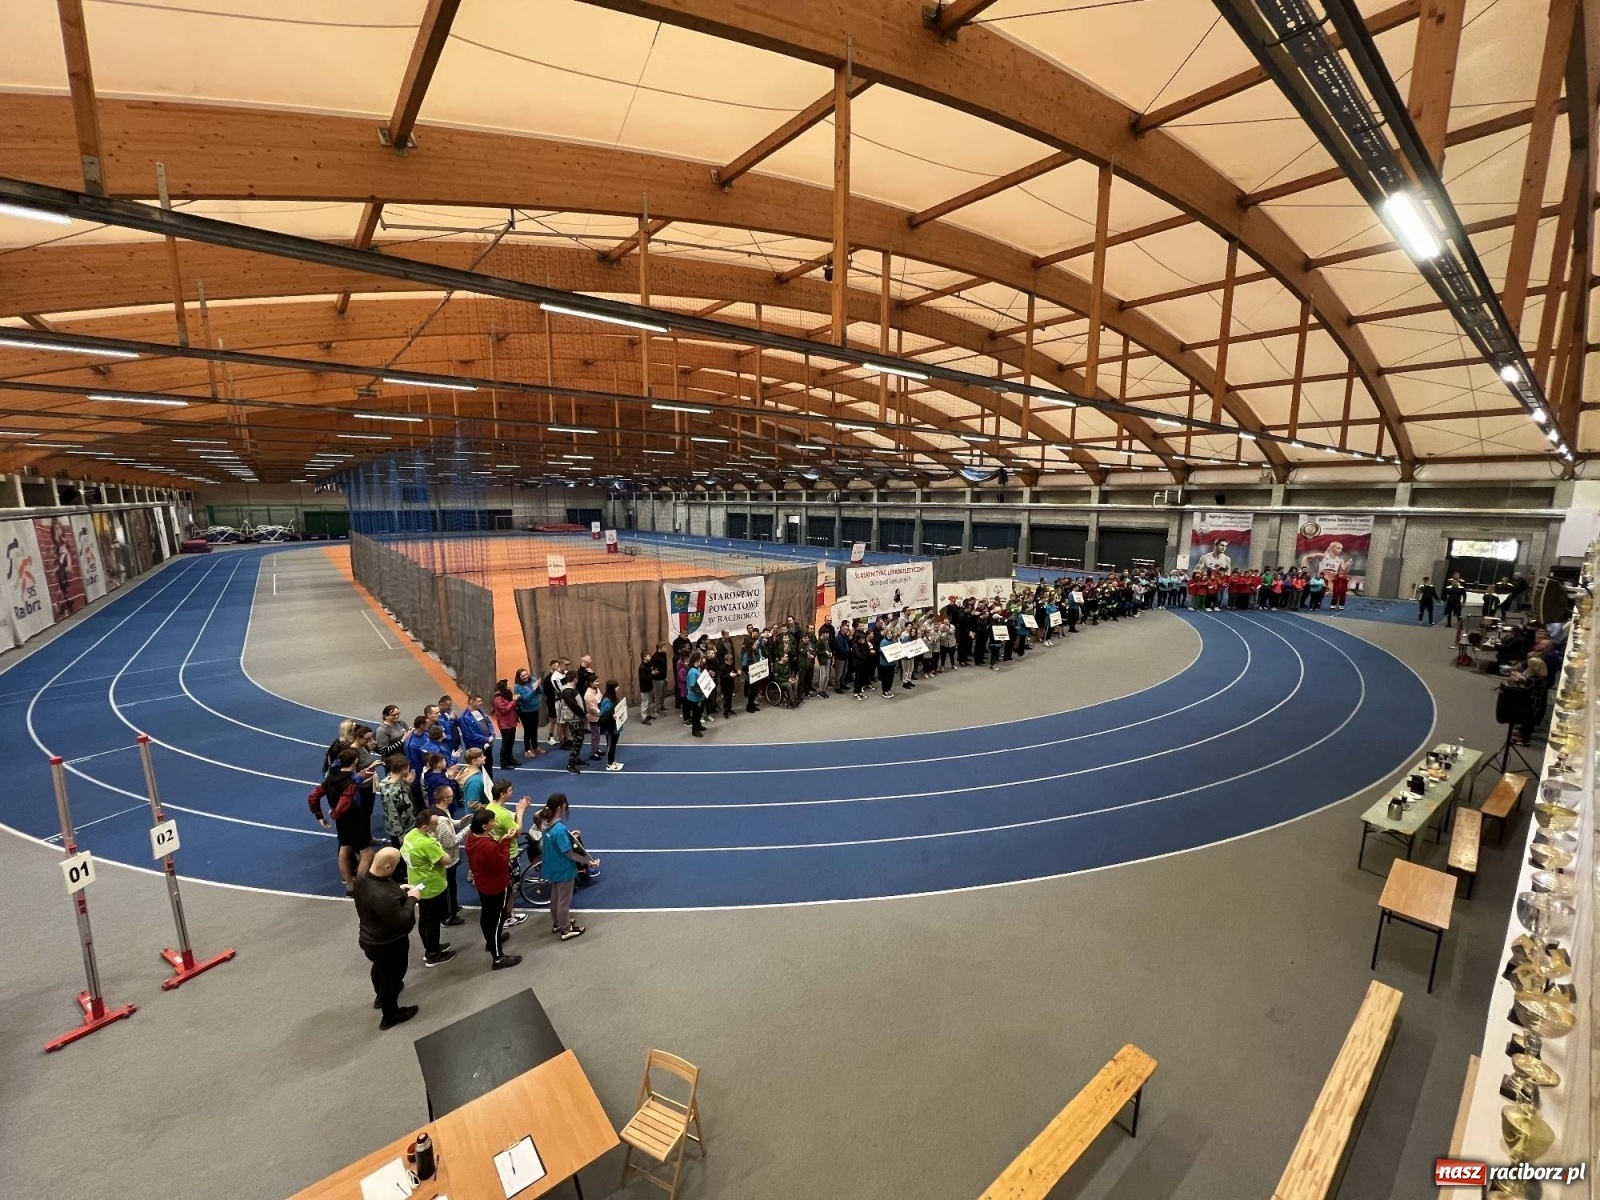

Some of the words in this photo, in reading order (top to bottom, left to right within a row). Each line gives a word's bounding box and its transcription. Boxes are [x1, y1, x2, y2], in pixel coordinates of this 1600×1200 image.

[708, 589, 760, 602] STAROSTWO
[708, 600, 760, 614] POWIATOWE
[708, 616, 716, 624] W
[717, 611, 760, 624] RACIBORZU
[156, 829, 174, 846] 02
[68, 861, 90, 883] 01
